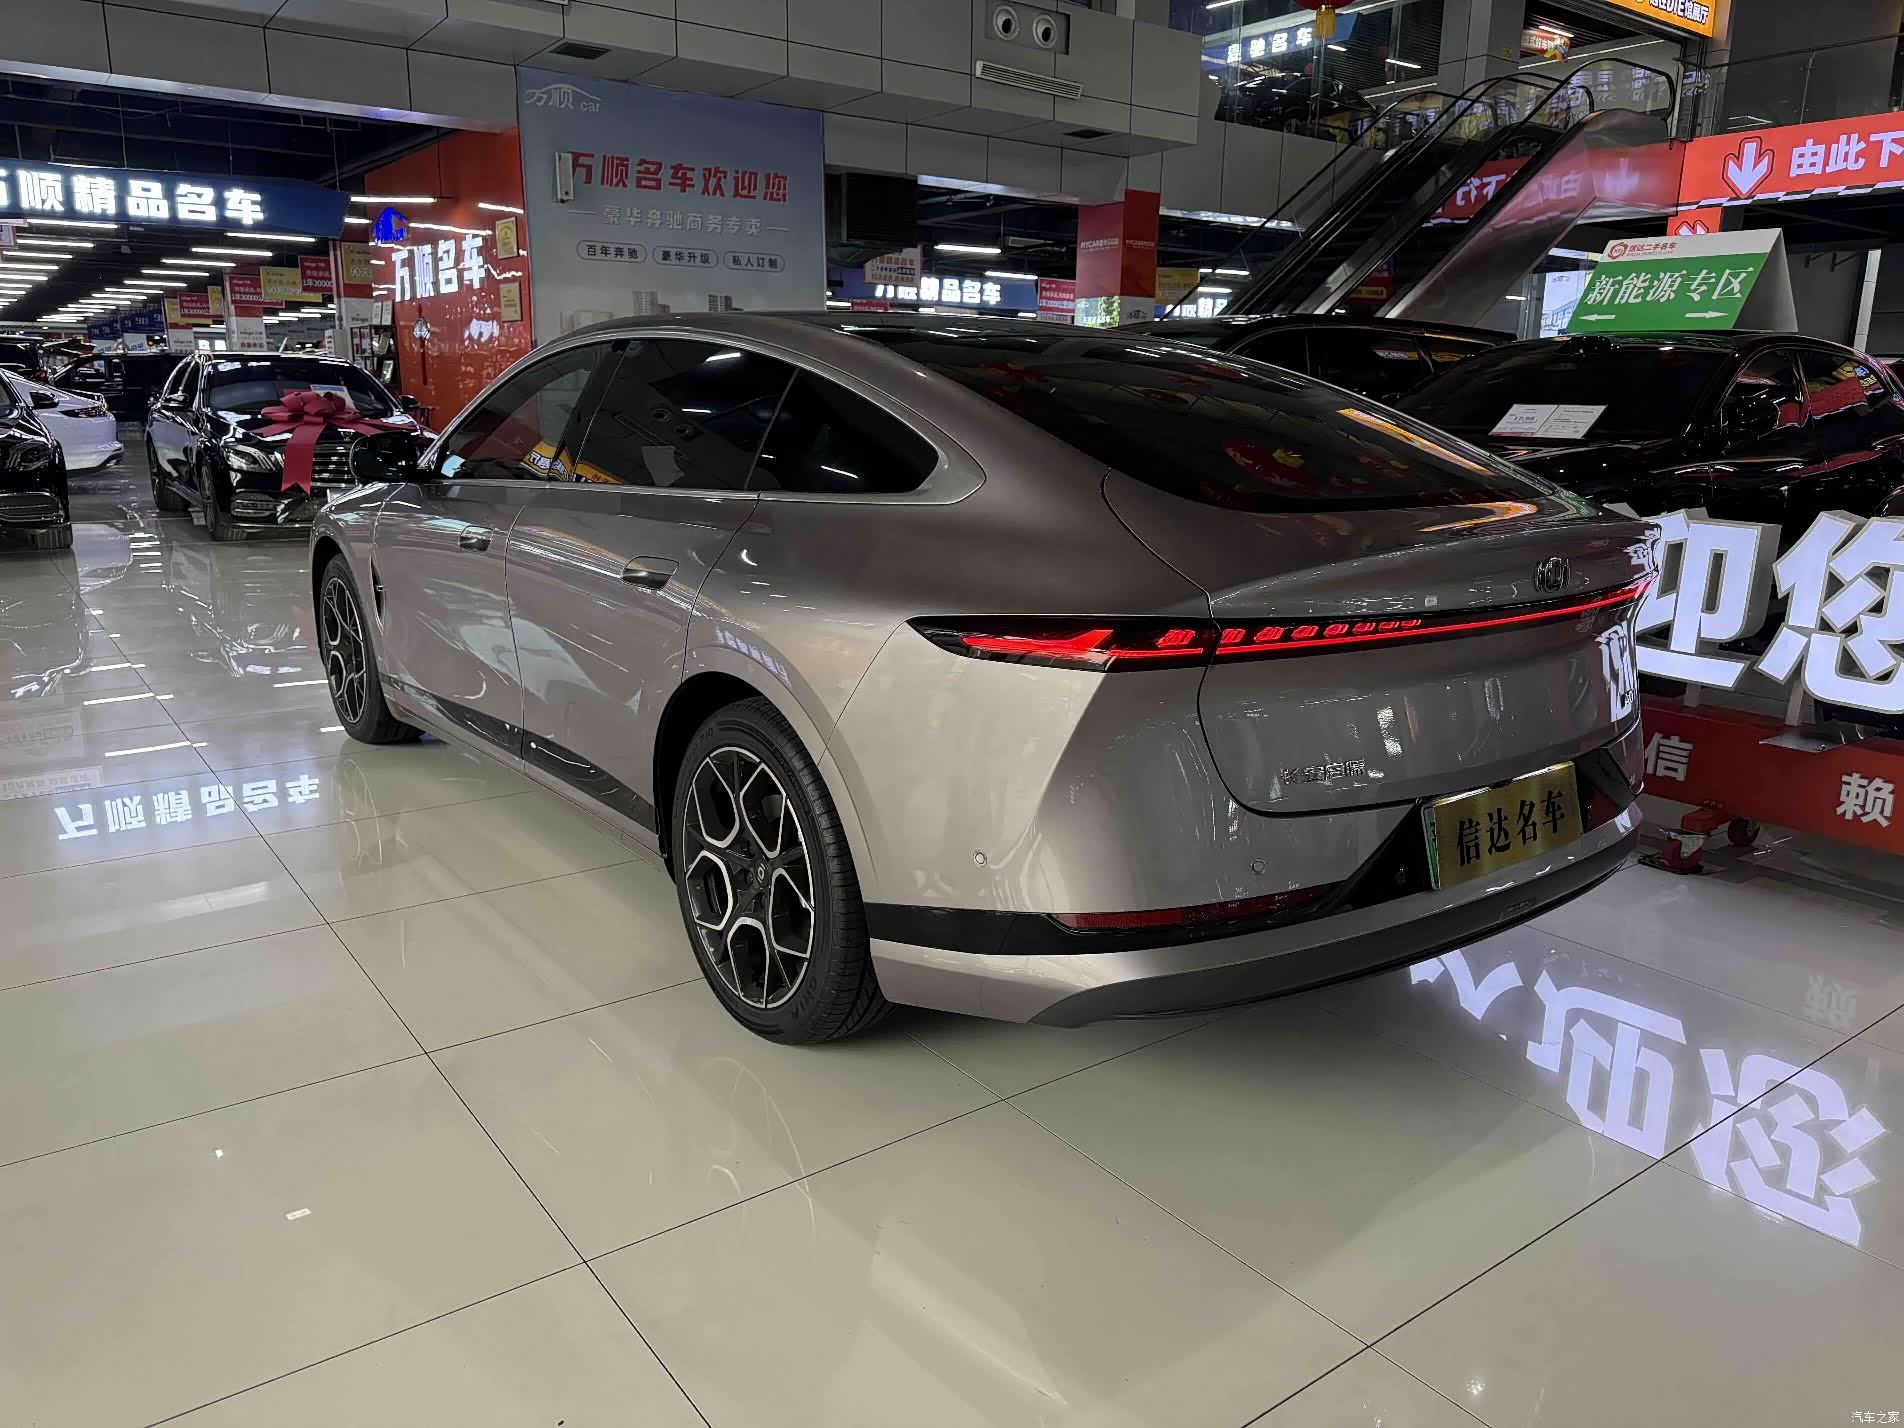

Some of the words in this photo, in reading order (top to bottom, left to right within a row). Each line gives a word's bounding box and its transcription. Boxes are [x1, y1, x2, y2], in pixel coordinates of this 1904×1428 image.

[0, 168, 264, 225] 顺精品名车
[568, 151, 789, 204] 万顺名车欢迎您
[603, 206, 762, 236] 豪华奔驰商务专卖
[391, 234, 486, 303] 万顺名车
[586, 244, 639, 260] 百年奔驰
[661, 249, 711, 265] 豪华升级
[732, 253, 779, 270] 私人订制
[1584, 267, 1755, 305] 新能源专区
[1645, 731, 1694, 782] 信
[1836, 773, 1896, 827] 赖
[1456, 789, 1566, 868] 信达名车
